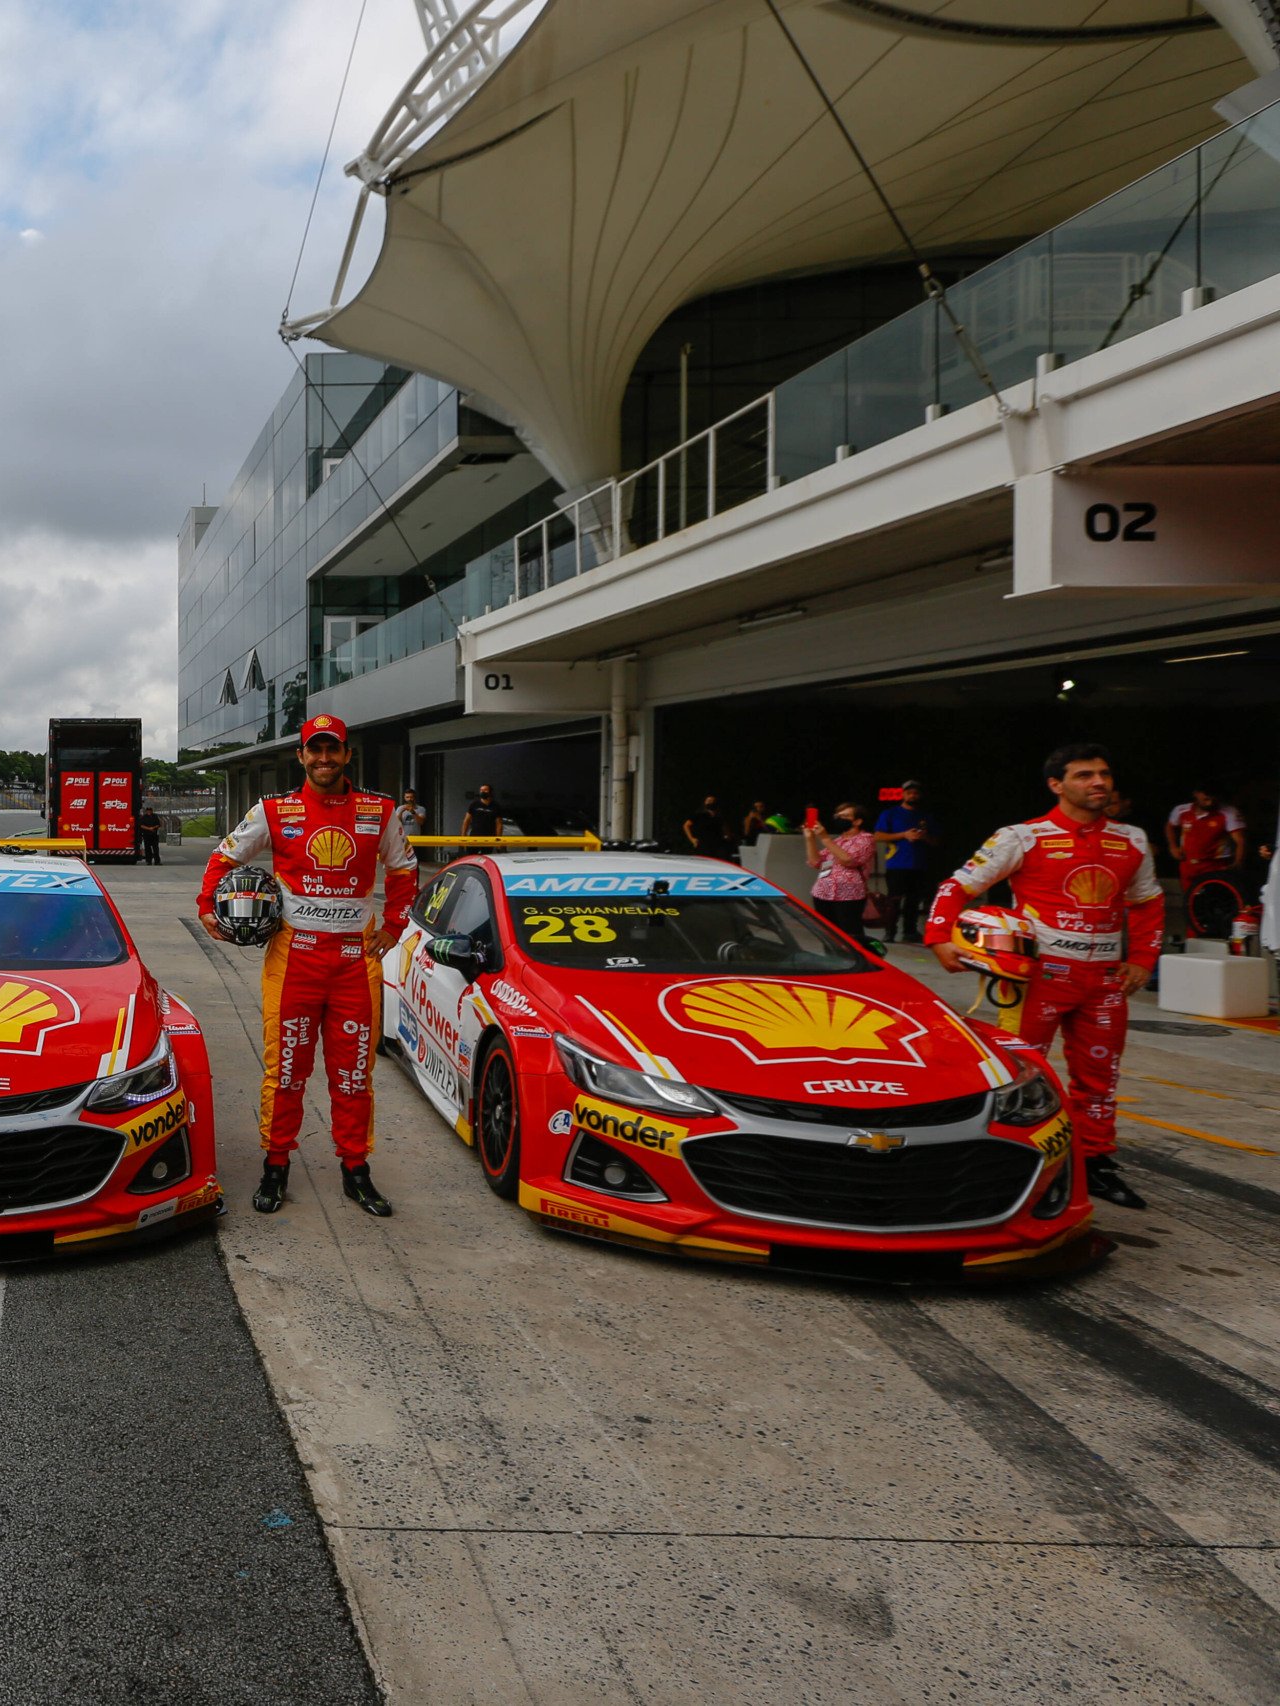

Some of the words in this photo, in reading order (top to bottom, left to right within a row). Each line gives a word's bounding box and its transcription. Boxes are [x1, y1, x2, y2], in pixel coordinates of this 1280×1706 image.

[1085, 502, 1157, 542] 02
[484, 673, 514, 690] 01
[302, 875, 323, 883] Shell
[303, 884, 356, 895] V-Power
[292, 905, 363, 919] AMORTEX
[523, 906, 544, 915] G.
[548, 906, 680, 916] OSMAN/ELIAS
[524, 915, 617, 943] 28
[412, 967, 459, 1055] V-Power
[299, 1017, 310, 1045] Shell
[425, 1043, 458, 1101] UNIFLEX
[803, 1079, 909, 1096] CRUZE
[574, 1102, 676, 1151] vonder
[540, 1198, 610, 1228] PIRELLI
